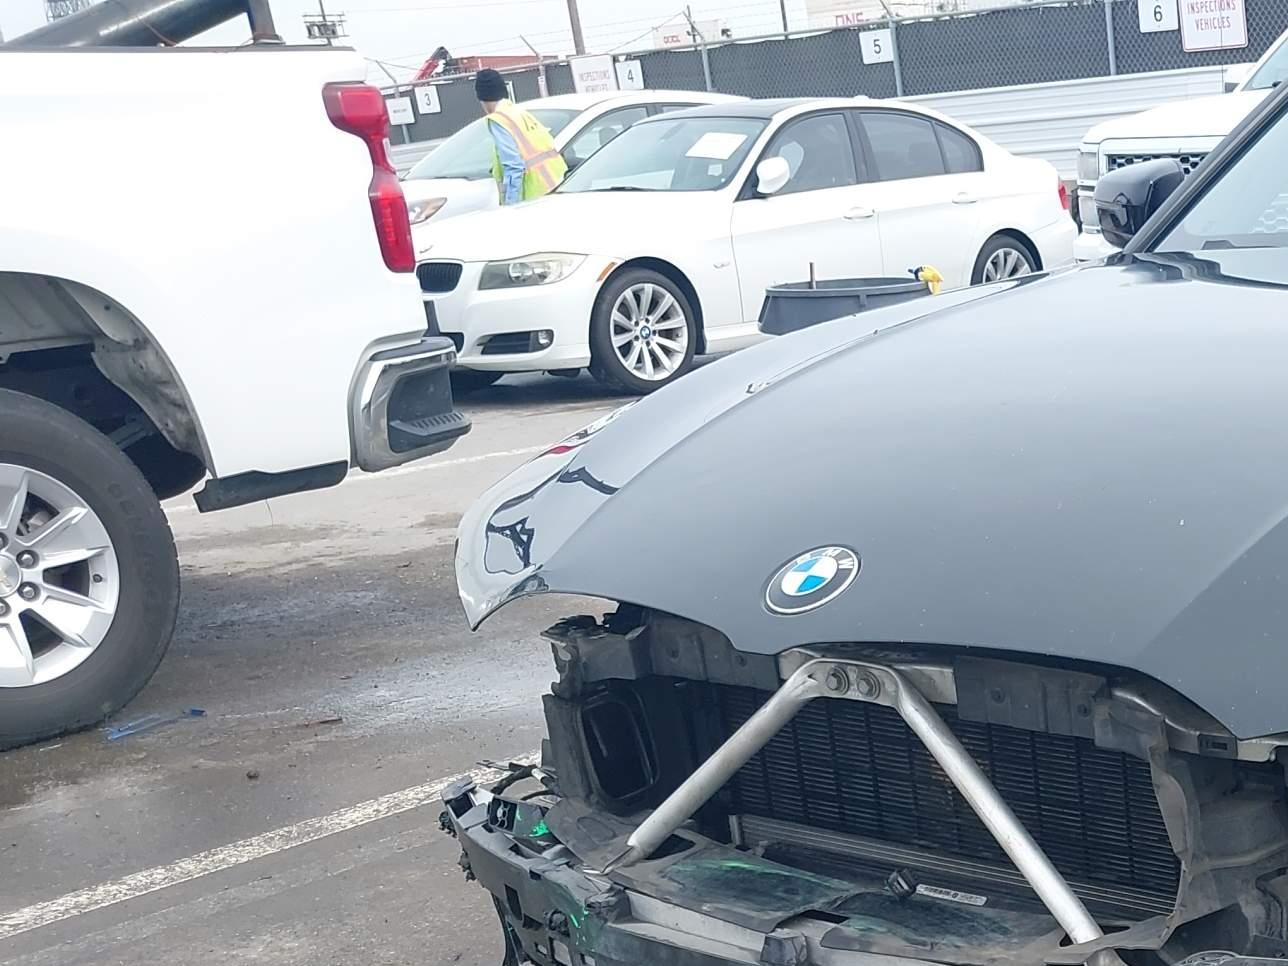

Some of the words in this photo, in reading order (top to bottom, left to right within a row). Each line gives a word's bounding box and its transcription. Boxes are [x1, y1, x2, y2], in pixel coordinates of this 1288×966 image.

[1153, 4, 1163, 22] 6
[1187, 0, 1236, 14] INSPECTIONS
[1194, 16, 1232, 31] VEHICLES
[873, 39, 882, 55] 5
[627, 69, 635, 83] 4
[424, 92, 432, 106] 3
